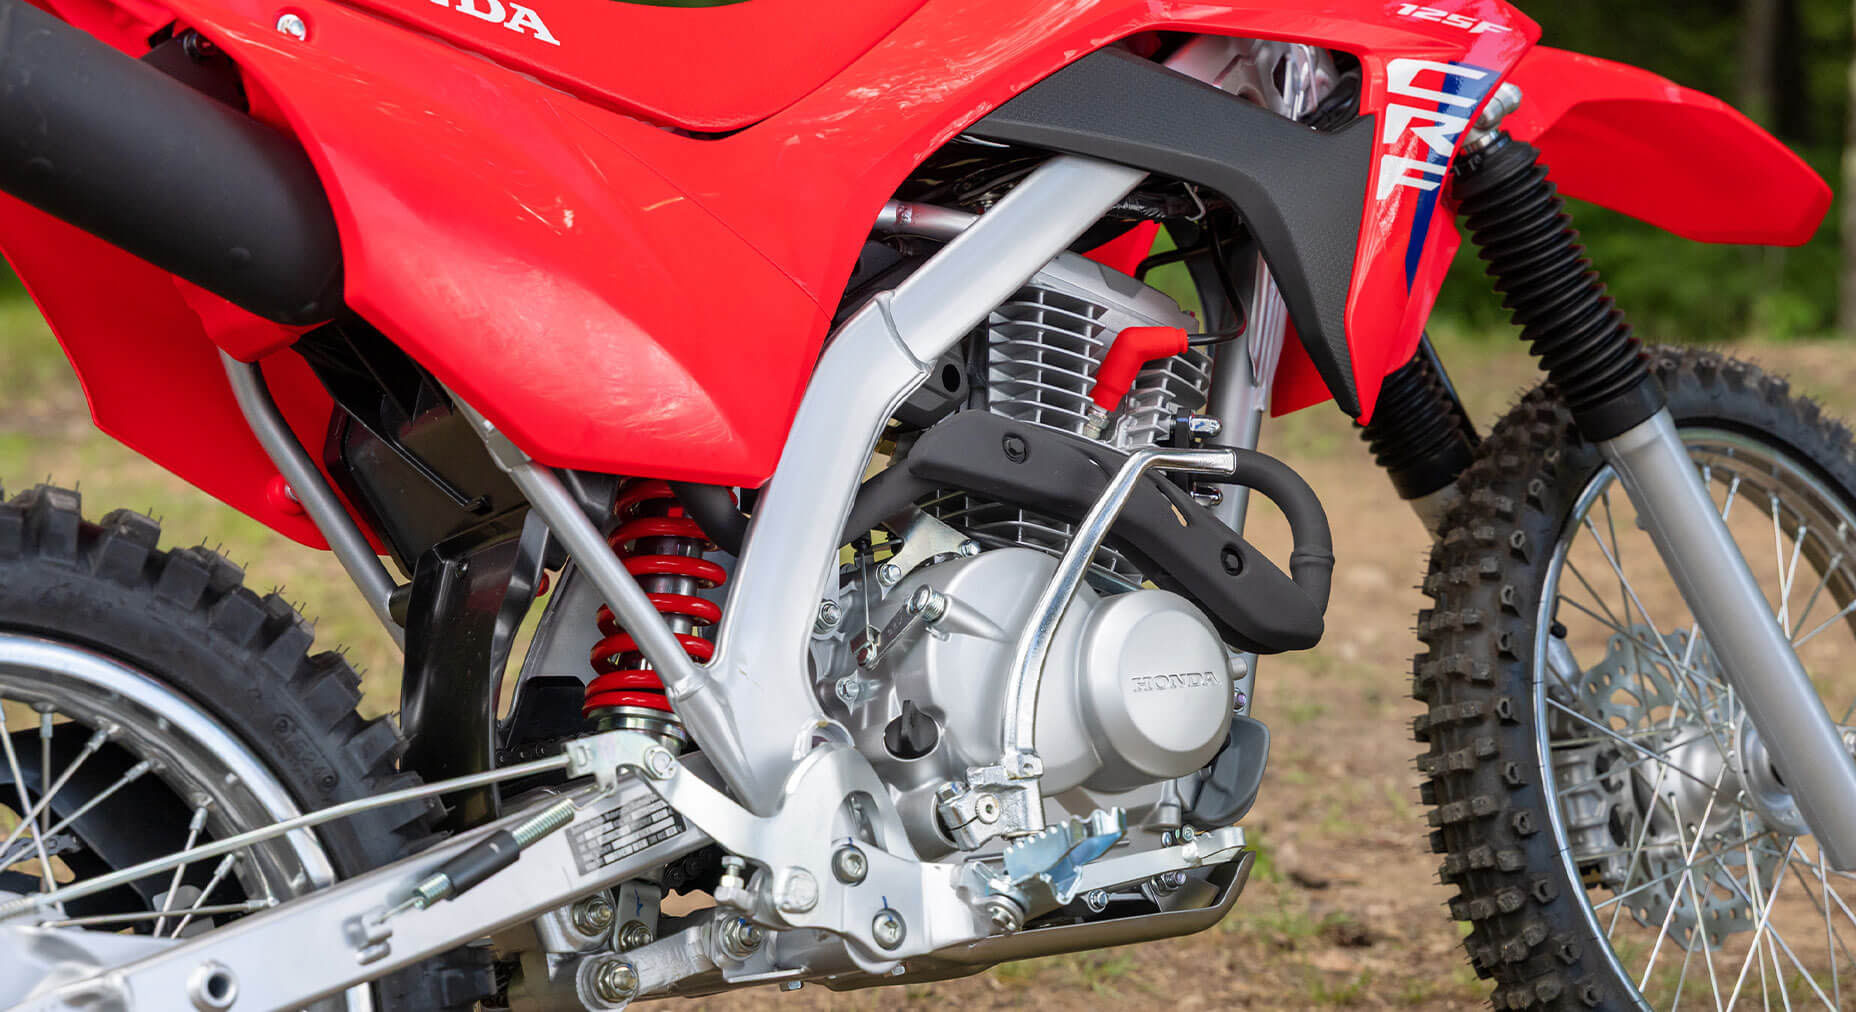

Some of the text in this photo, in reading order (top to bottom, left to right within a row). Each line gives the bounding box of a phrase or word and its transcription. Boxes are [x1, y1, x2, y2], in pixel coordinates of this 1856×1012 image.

[1397, 3, 1512, 34] 125F
[1376, 58, 1488, 201] CRF
[1131, 671, 1222, 693] HONDA
